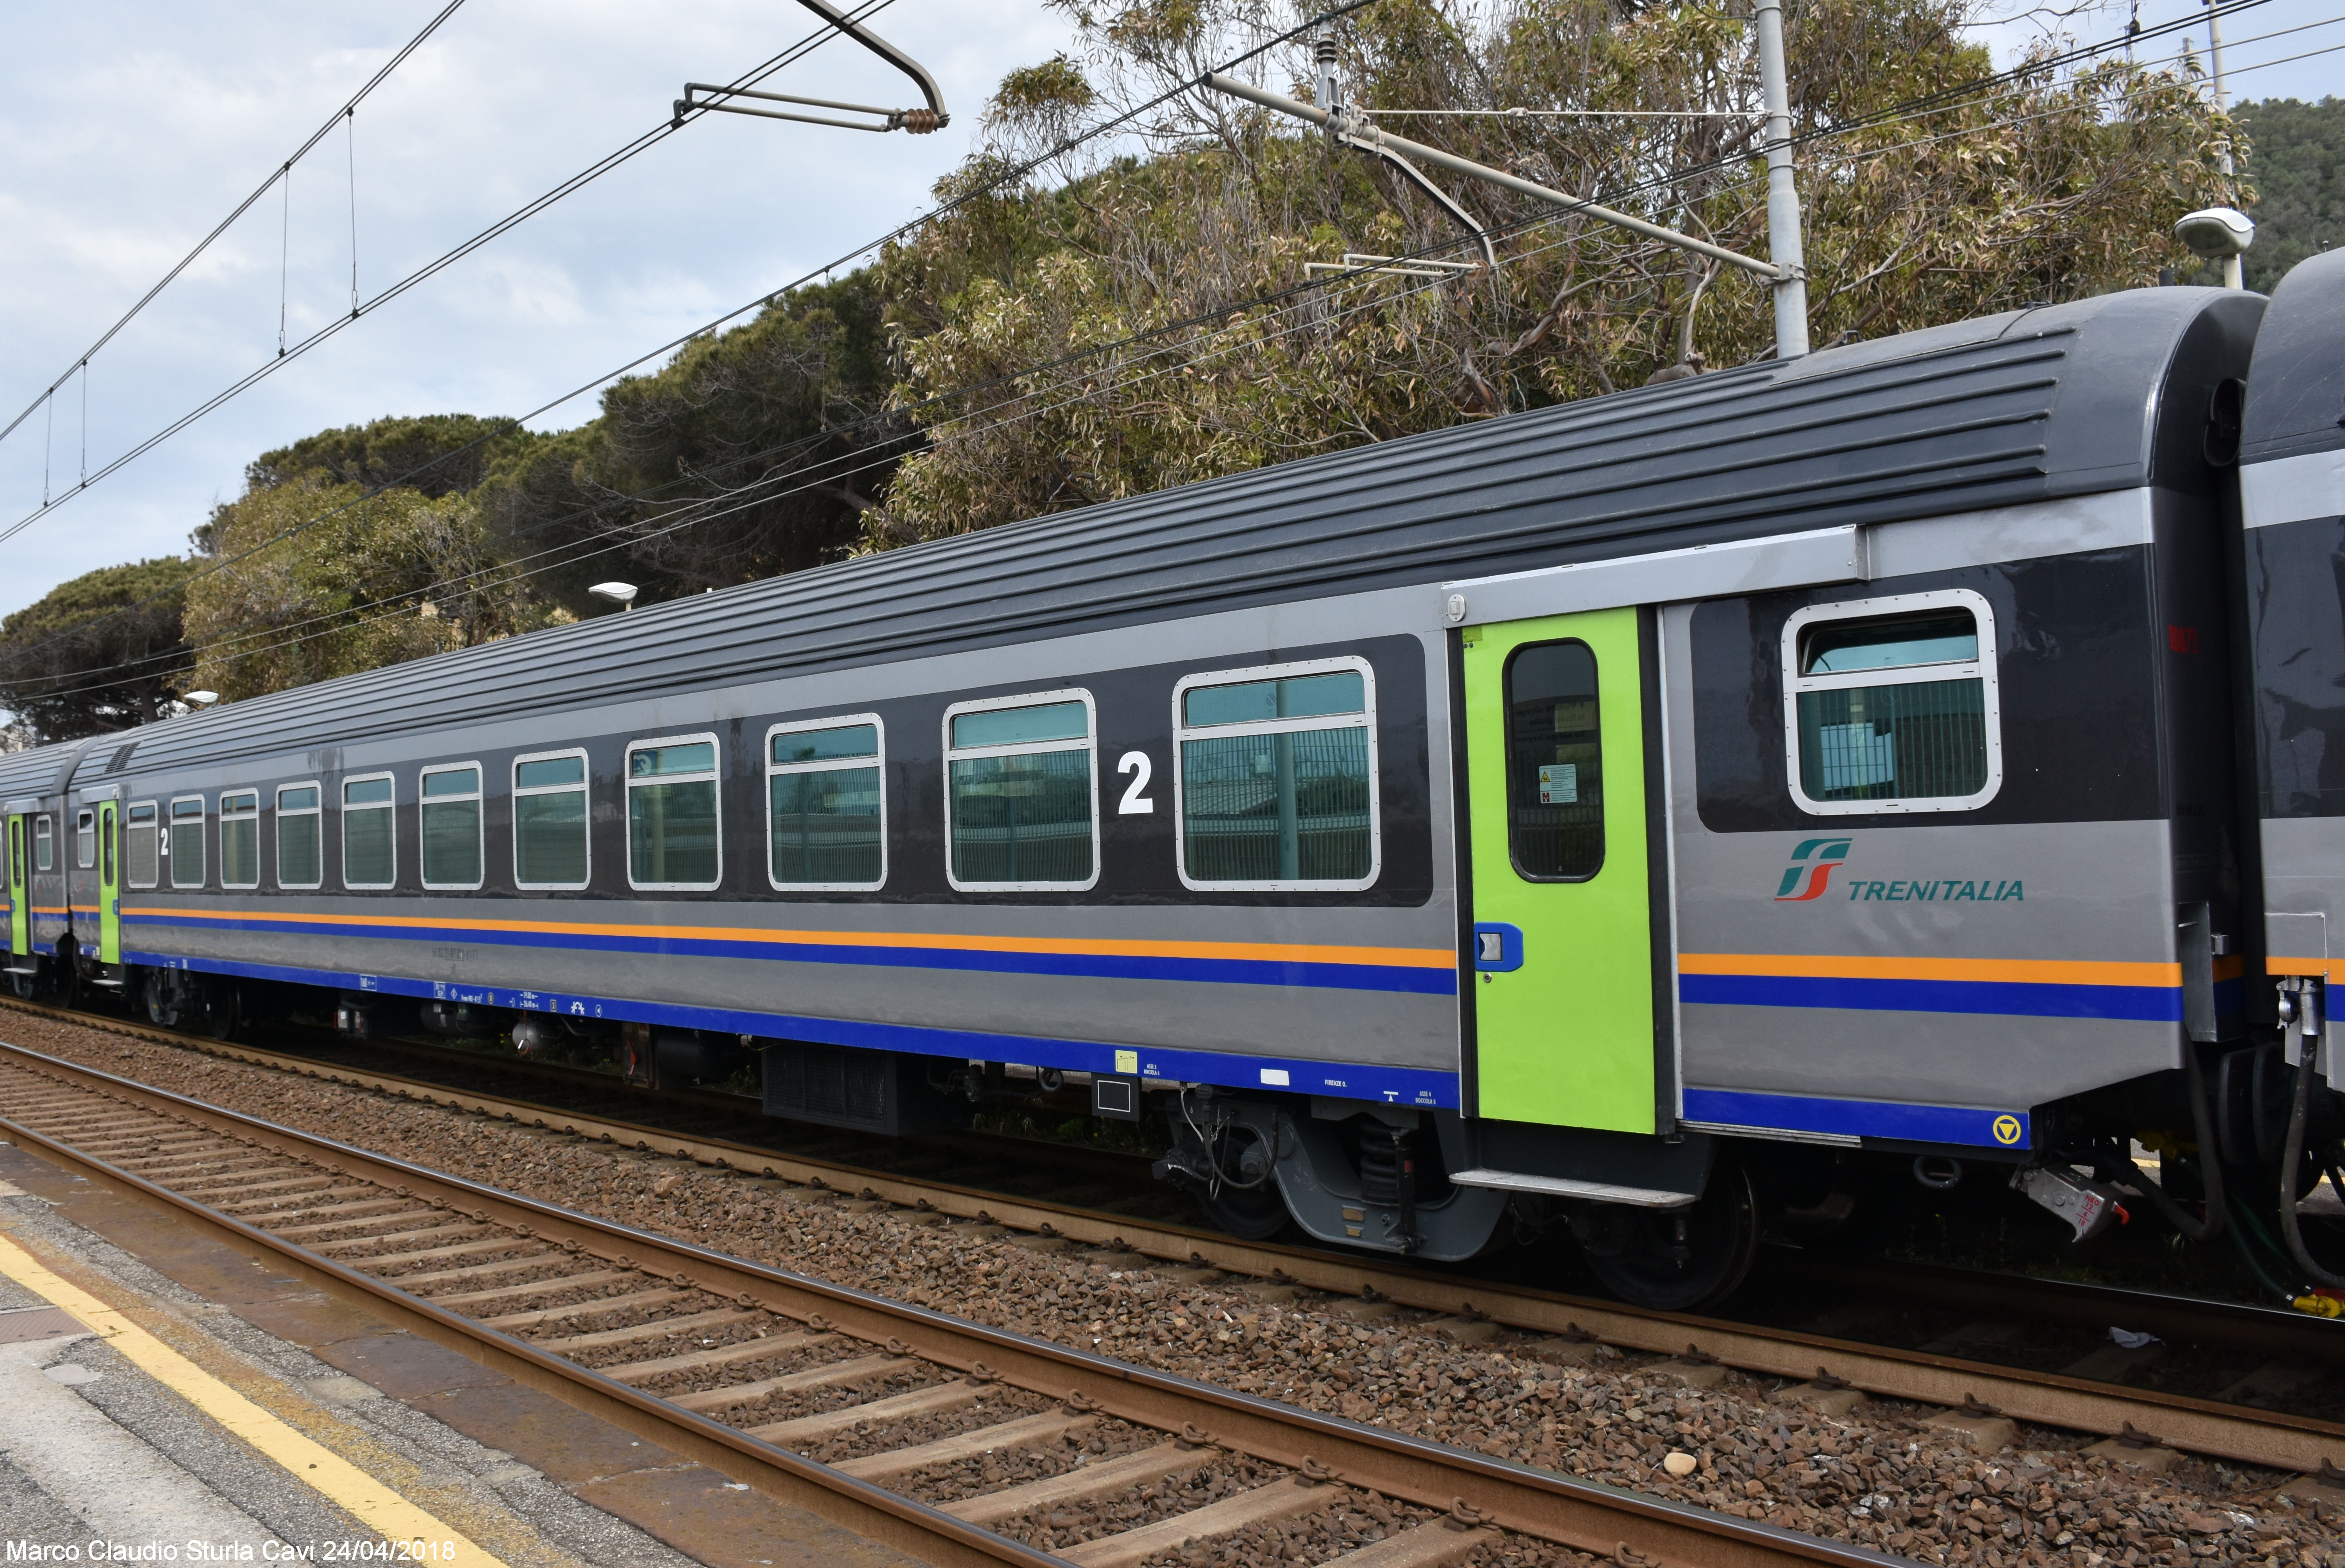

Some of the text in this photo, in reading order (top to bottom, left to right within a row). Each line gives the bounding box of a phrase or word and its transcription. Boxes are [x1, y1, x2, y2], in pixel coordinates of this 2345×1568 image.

[1118, 751, 1153, 815] 2
[160, 828, 169, 855] 2
[1849, 880, 2024, 901] TRENITALIA
[1190, 1105, 1193, 1114] 6
[2085, 1194, 2099, 1206] NBO
[2078, 1218, 2085, 1226] 18
